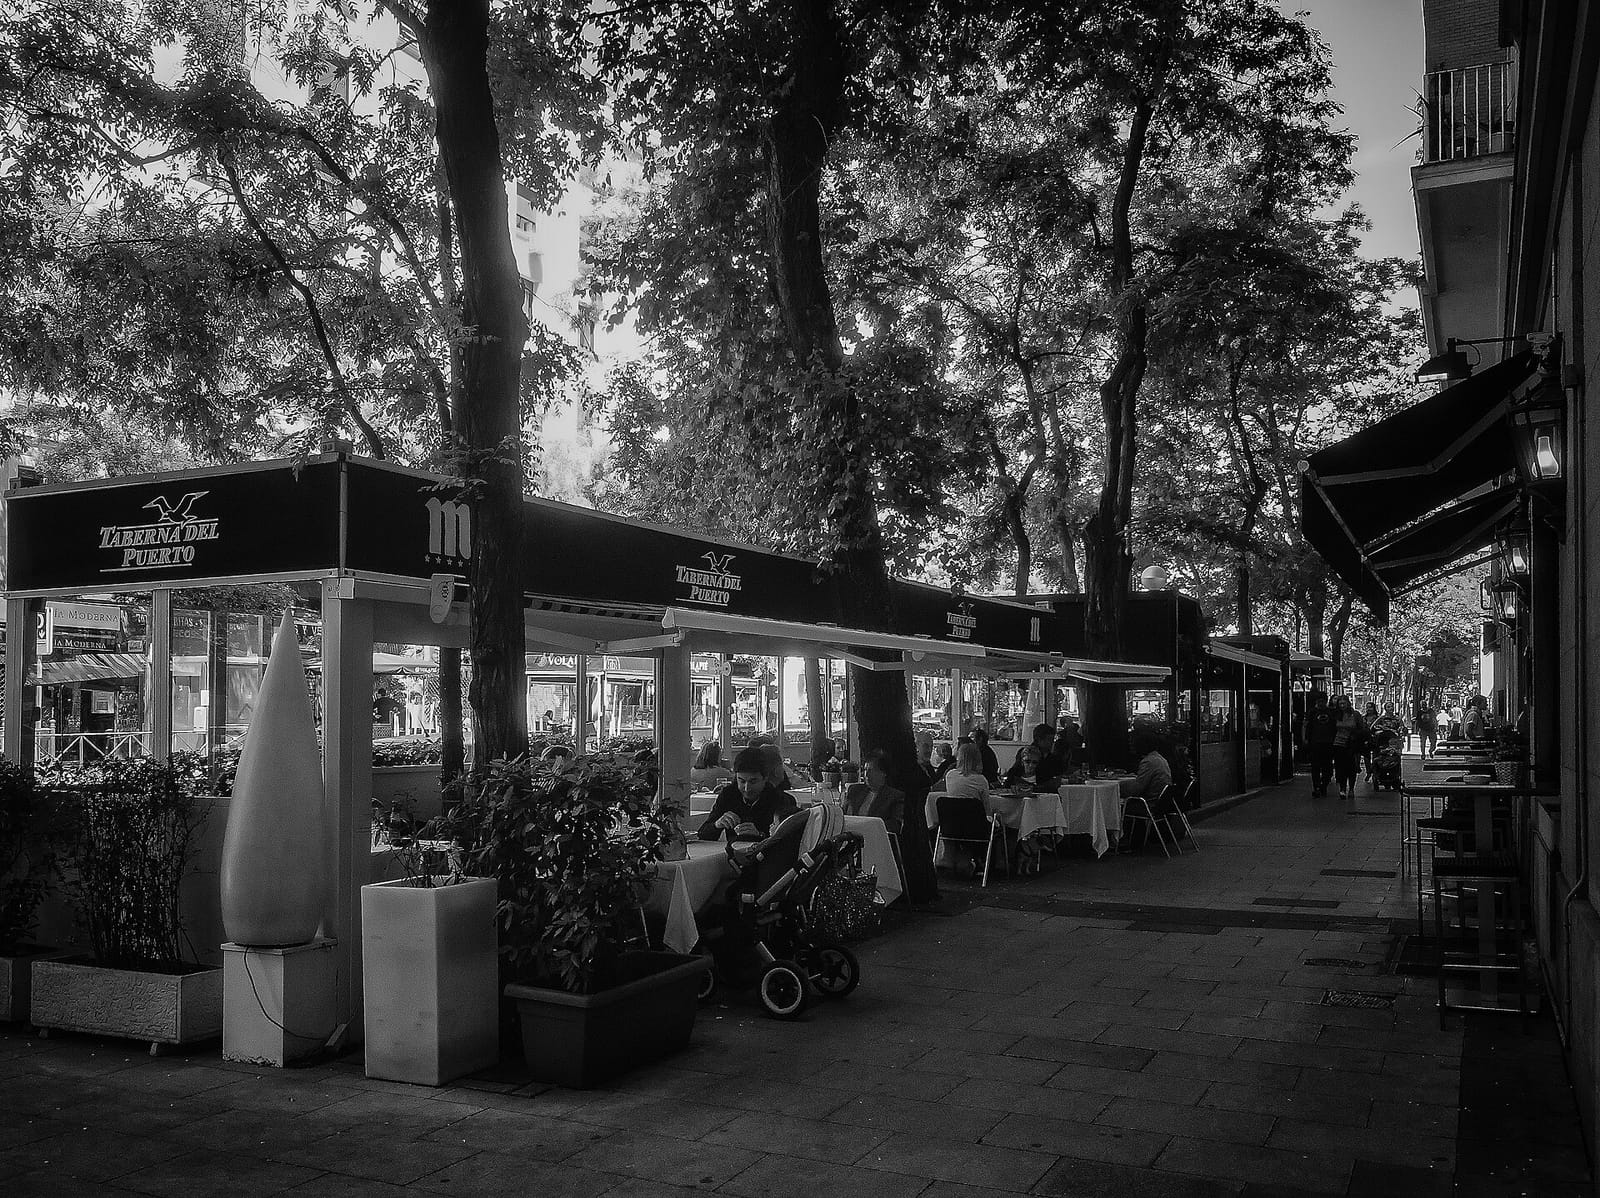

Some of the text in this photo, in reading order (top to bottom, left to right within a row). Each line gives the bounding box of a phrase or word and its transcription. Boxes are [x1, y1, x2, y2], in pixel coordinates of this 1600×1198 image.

[98, 522, 220, 549] TABERNA DEL
[120, 545, 196, 567] PUERTO
[675, 564, 742, 591] TABERNA DEL
[689, 585, 730, 603] PUERTO
[68, 610, 118, 622] MODERNA
[64, 638, 106, 649] MODERNA
